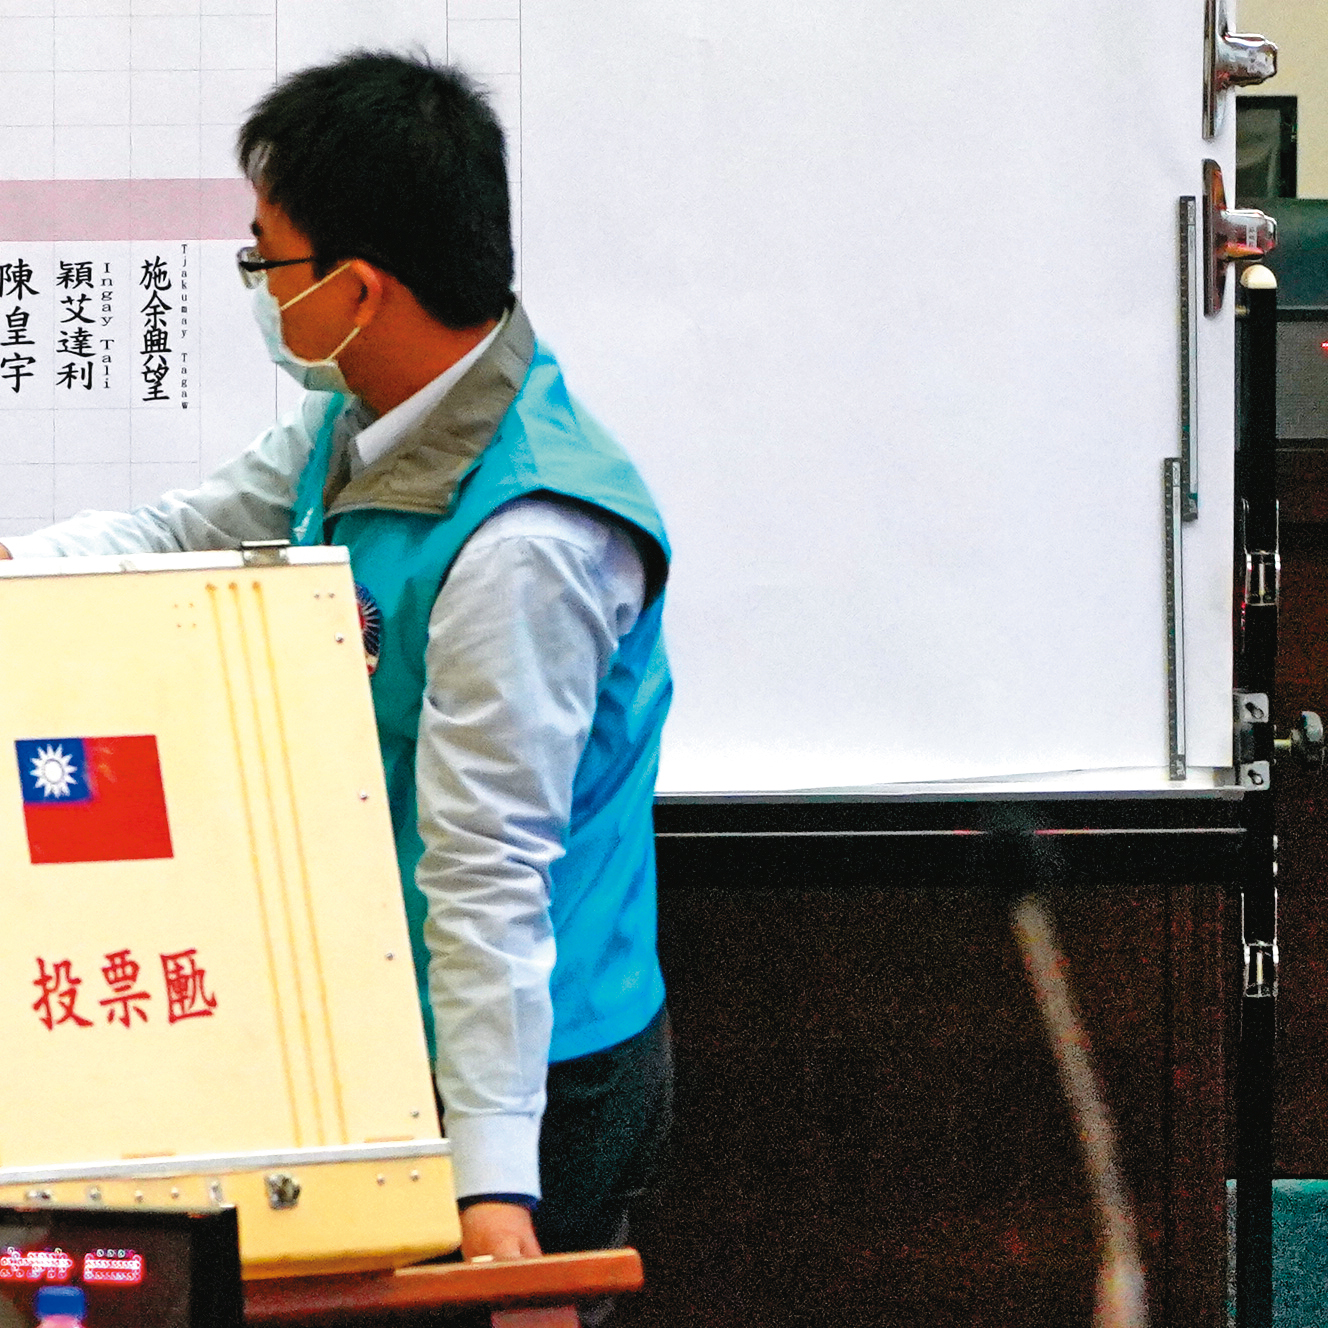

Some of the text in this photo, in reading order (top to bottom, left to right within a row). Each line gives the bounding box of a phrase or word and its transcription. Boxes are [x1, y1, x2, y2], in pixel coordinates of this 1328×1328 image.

[0, 259, 38, 393] 陳皇宇
[101, 263, 114, 388] Ingay Tali
[140, 256, 171, 401] 施余興望
[33, 949, 217, 1030] 投票匭
